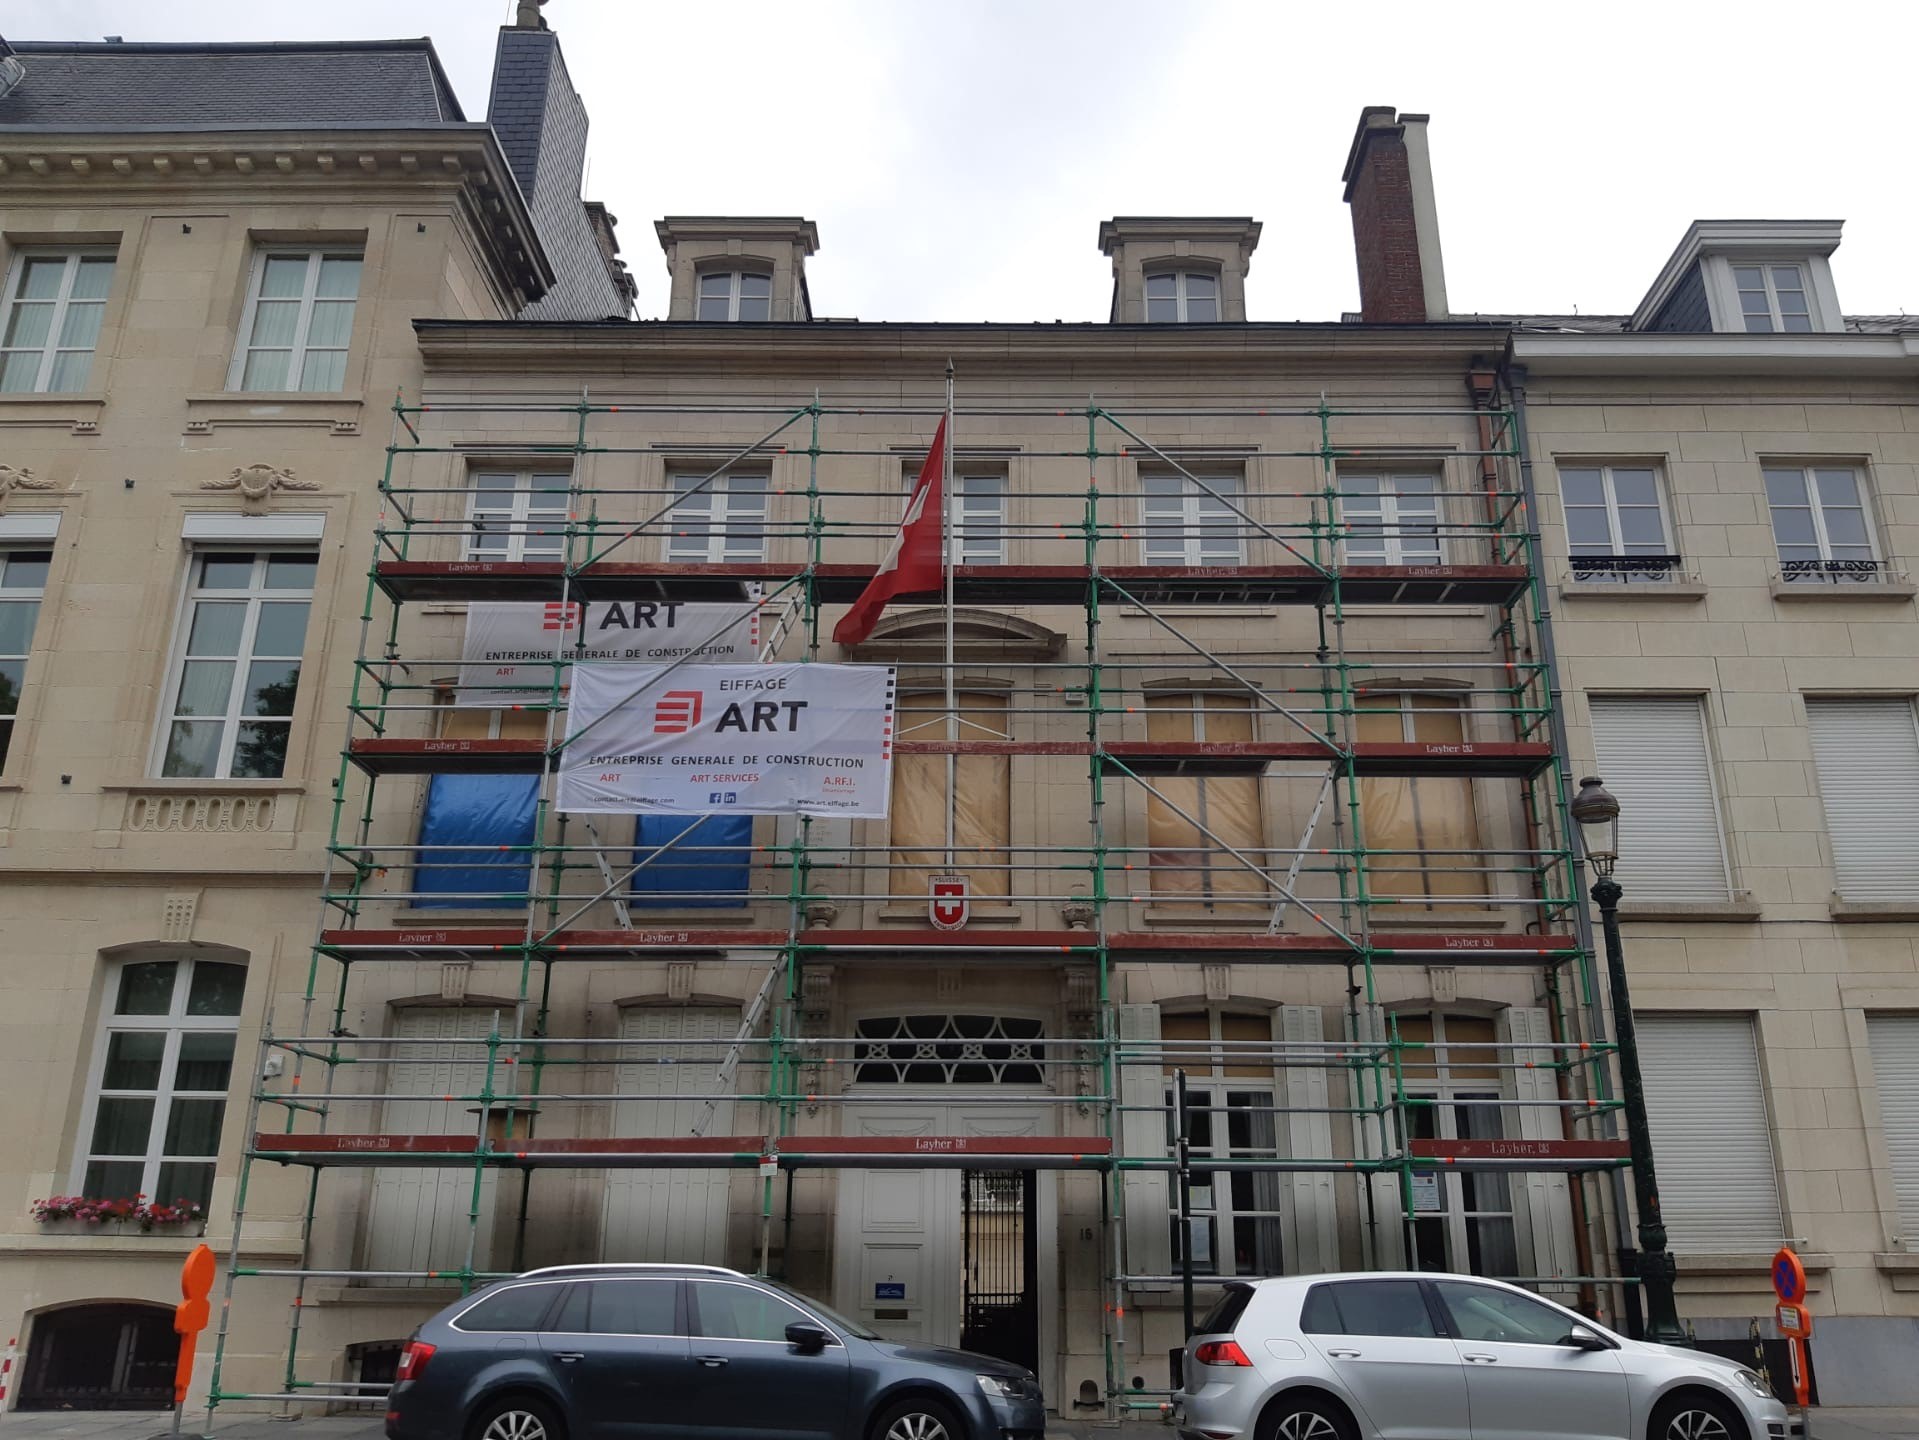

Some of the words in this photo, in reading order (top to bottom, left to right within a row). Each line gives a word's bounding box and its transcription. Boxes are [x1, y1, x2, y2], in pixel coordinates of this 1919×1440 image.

[599, 601, 684, 630] ART
[486, 651, 553, 660] ENTREPRISE
[625, 649, 641, 657] DE
[496, 668, 515, 676] ART
[720, 678, 788, 691] EIFFAGE
[714, 701, 808, 732] ART
[589, 756, 664, 765] ENTREPRISE
[671, 755, 735, 765] GENERALE
[743, 755, 759, 764] DE
[766, 755, 864, 768] CONSTRUCTION
[600, 774, 621, 782] ART
[690, 774, 711, 783] ART
[713, 773, 759, 783] SERVICES
[916, 1138, 952, 1151] Layher
[1080, 1228, 1092, 1240] 16
